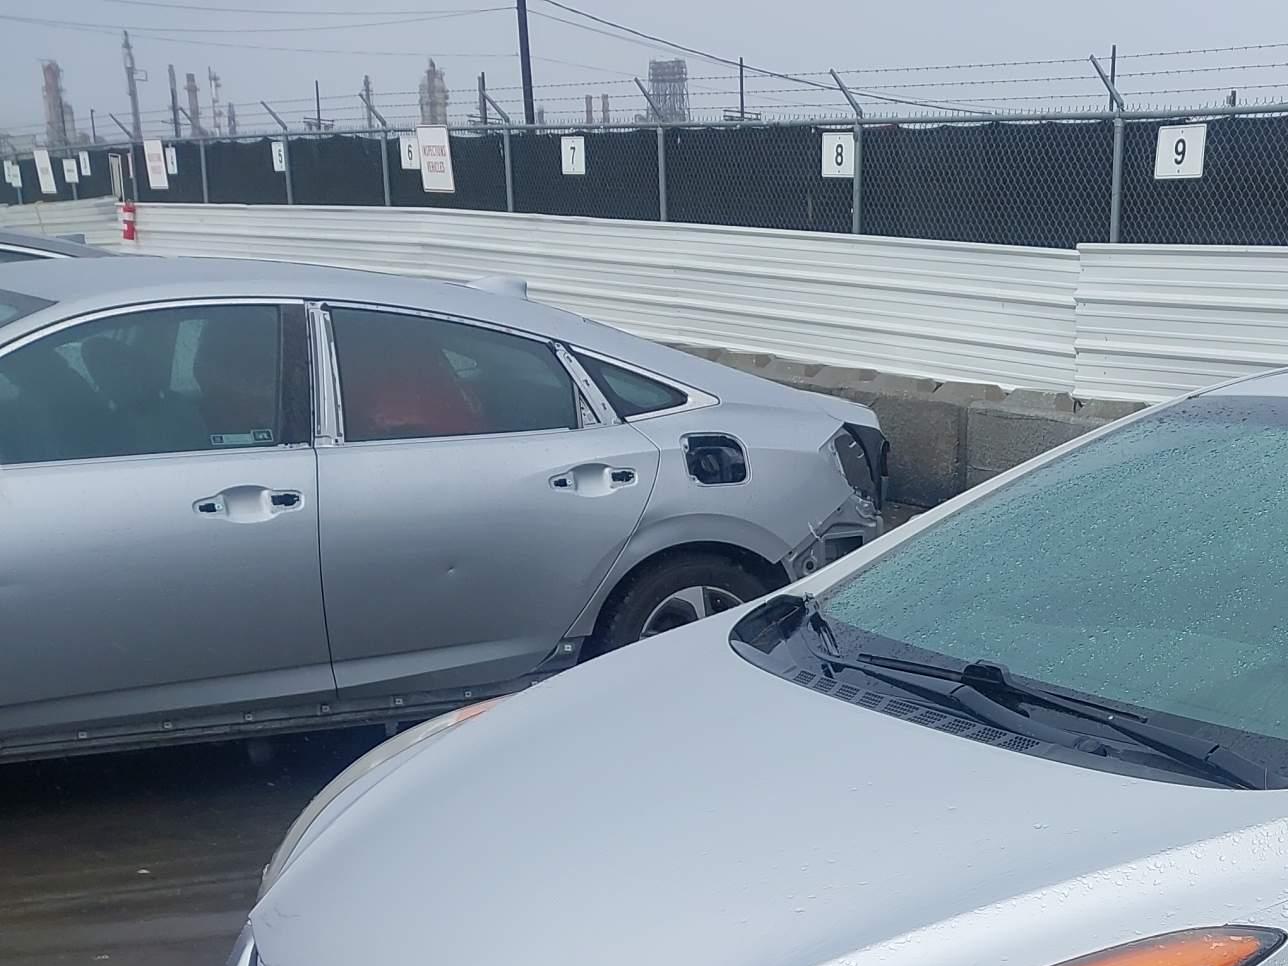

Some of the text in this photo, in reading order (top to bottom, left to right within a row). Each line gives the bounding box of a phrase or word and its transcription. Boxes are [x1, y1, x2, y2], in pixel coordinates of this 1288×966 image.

[407, 144, 413, 161] 6
[570, 146, 576, 165] 7
[835, 143, 844, 167] 8
[1174, 138, 1187, 165] 9
